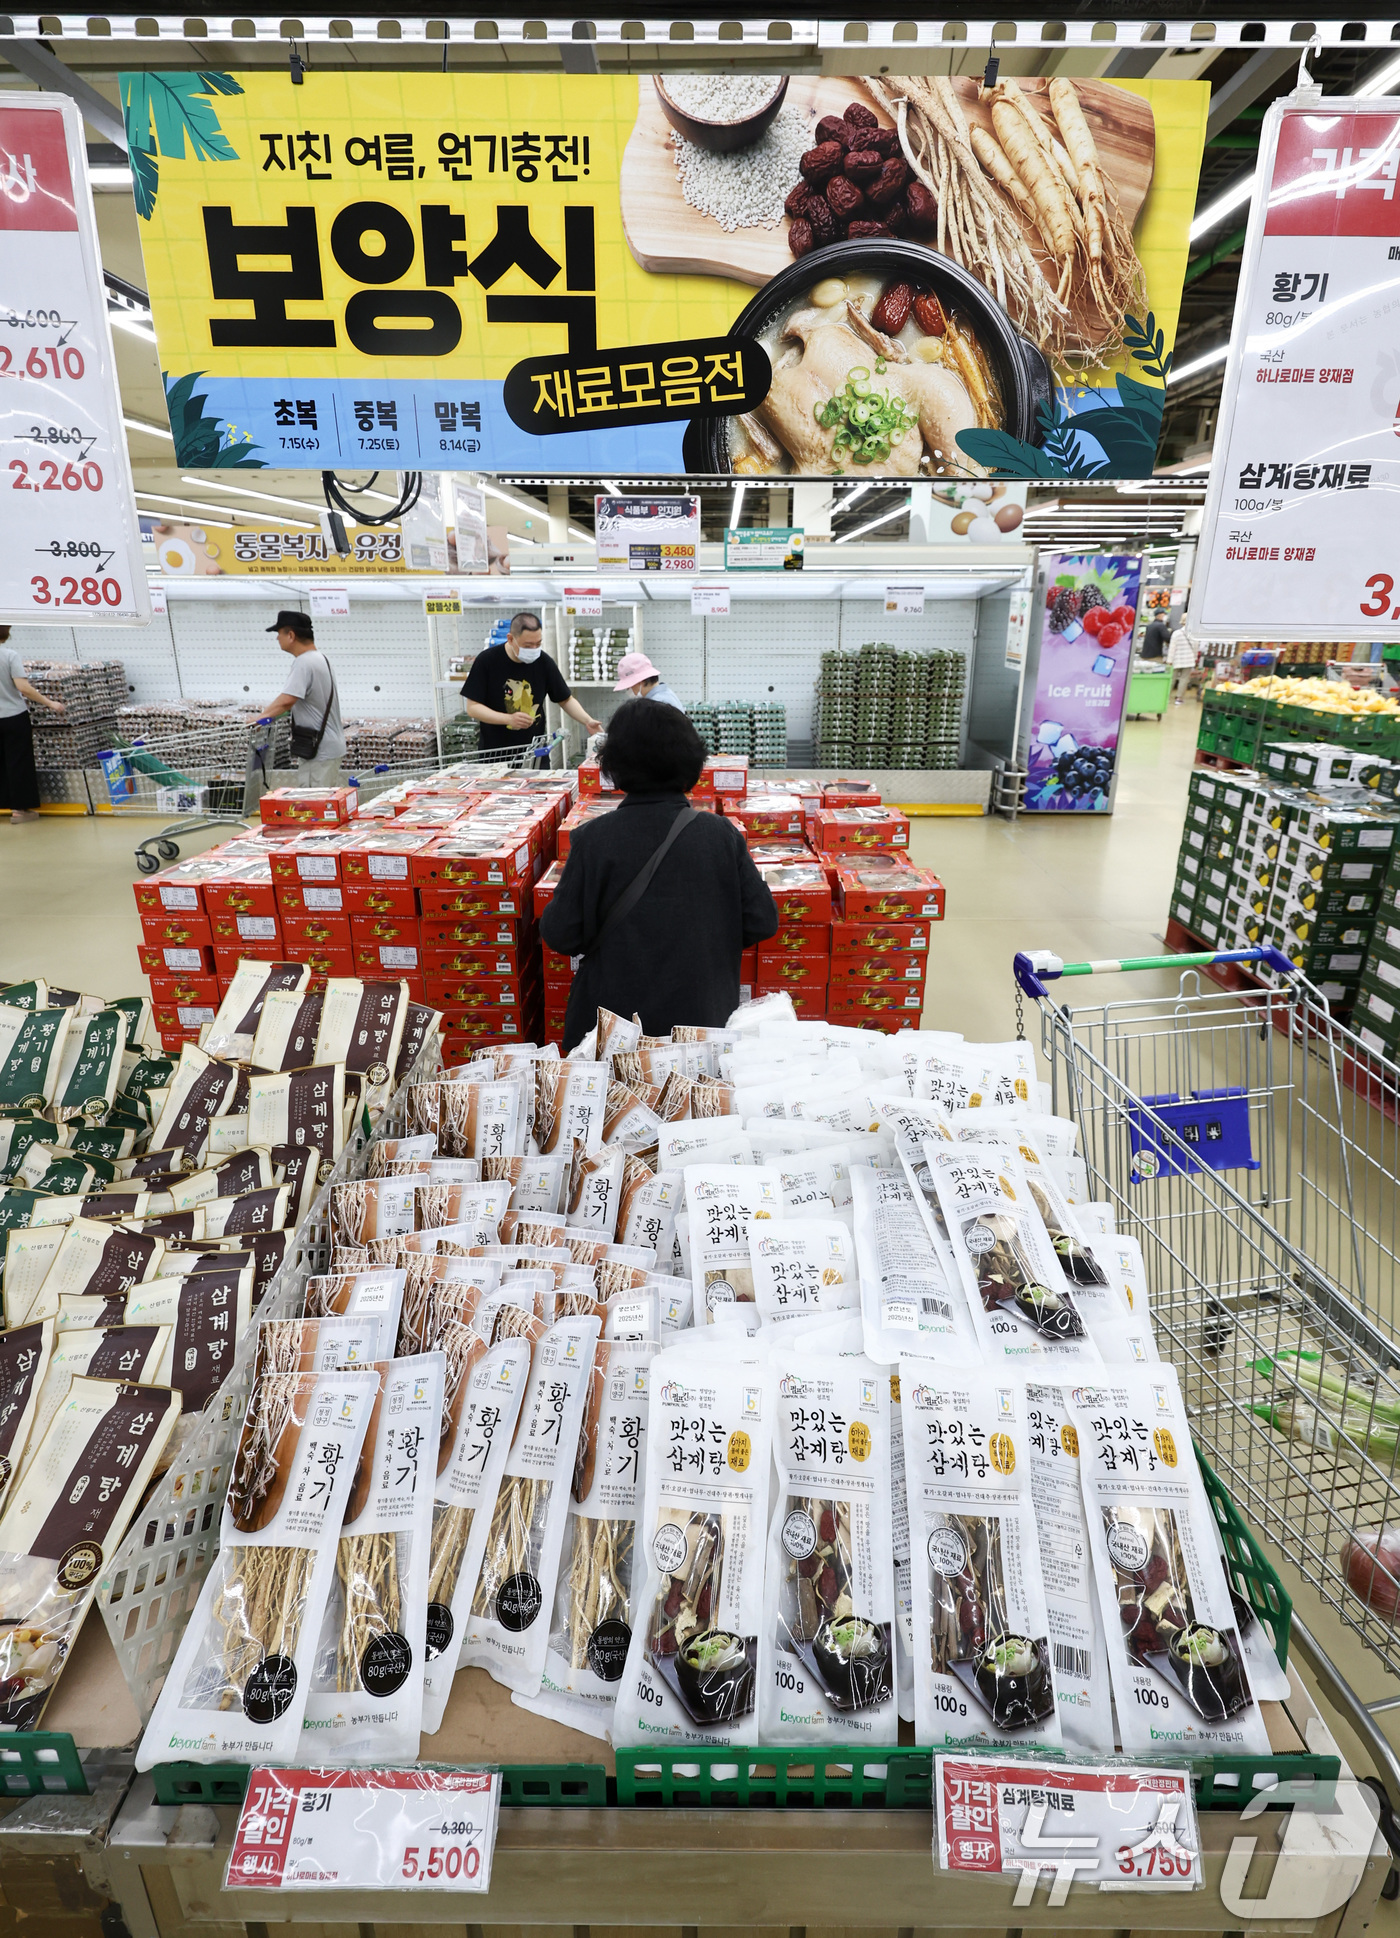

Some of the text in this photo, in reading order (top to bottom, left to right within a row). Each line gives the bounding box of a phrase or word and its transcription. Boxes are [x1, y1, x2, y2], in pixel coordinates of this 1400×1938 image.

[260, 131, 591, 183] 지친 여름, 원기충전!
[201, 200, 597, 357] 보양식
[1272, 272, 1329, 302] 황기
[8, 310, 61, 328] 3,600
[0, 347, 85, 381] 2,610
[1260, 350, 1285, 363] 국산
[531, 348, 746, 418] 재료모음전
[1256, 369, 1354, 384] 하나로마트 양재점
[275, 399, 481, 432] 초복 중복 말복
[31, 427, 82, 444] 2,800
[279, 435, 481, 453] 7.15(수) 7.25(토) 8.14(금)
[9, 460, 103, 492] 2,260
[1238, 463, 1372, 490] 삼계탕재료
[50, 541, 101, 558] 3,800
[234, 532, 330, 562] 동물복지
[1229, 531, 1252, 542] 국산
[665, 546, 694, 556] 3,480
[1226, 547, 1316, 561] 하나로마트 양재점
[665, 559, 694, 571] 2,980
[30, 576, 122, 607] 3,280
[1048, 684, 1113, 698] Ice Fruit
[374, 994, 395, 1043] 삼계탕
[36, 1023, 56, 1053] 황기
[407, 1012, 429, 1055] 삼계탕
[11, 1025, 36, 1072] 삼계탕
[80, 1029, 100, 1076] 삼계탕
[195, 1078, 225, 1133] 삼계탕
[311, 1081, 329, 1139] 삼계탕
[951, 1167, 995, 1183] 맛있는
[592, 1178, 613, 1225] 황기
[707, 1204, 752, 1223] 맛있는
[771, 1262, 819, 1281] 맛있는
[207, 1285, 231, 1361] 삼계탕
[542, 1382, 571, 1446] 황기
[790, 1407, 846, 1433] 맛있는
[468, 1406, 501, 1472] 황기
[670, 1416, 727, 1443] 맛있는
[851, 1427, 866, 1438] 6가지
[926, 1420, 985, 1446] 맛있는
[1091, 1416, 1149, 1441] 맛있는
[618, 1416, 646, 1484] 황기
[731, 1437, 747, 1447] 6가지
[790, 1435, 848, 1464] 삼계탕
[852, 1447, 865, 1457] 재료
[98, 1411, 154, 1502] 삼계탕
[395, 1426, 424, 1493] 황기
[665, 1445, 726, 1475] 삼계탕
[731, 1457, 745, 1467] 재료
[926, 1449, 990, 1478] 삼계탕
[1098, 1444, 1158, 1471] 삼계탕
[309, 1443, 344, 1511] 황기
[83, 1508, 102, 1532] 재료
[69, 1558, 93, 1571] 100%
[368, 1663, 405, 1677] 80g(국산)
[775, 1670, 804, 1694] 100g
[637, 1681, 663, 1706] 100g
[933, 1694, 967, 1716] 100g
[1133, 1687, 1169, 1709] 100g
[303, 1711, 398, 1730] beyond farm 농부가 만듭니다
[638, 1716, 730, 1747] beyond farm 농부가 만듭니다
[780, 1706, 872, 1732] beyond farm 농부가 만듭니다
[168, 1731, 273, 1751] beyond farm 농부가 만듭니다
[945, 1731, 974, 1746] beyond
[1150, 1723, 1244, 1743] beyond farm 농부가 만듭니다
[252, 1787, 292, 1814] 가격
[302, 1792, 331, 1812] 황기
[950, 1779, 992, 1806] 가격
[1002, 1788, 1076, 1812] 삼계탕재료
[242, 1815, 288, 1845] 할인
[440, 1821, 473, 1834] 6,300
[952, 1805, 993, 1832] 할인
[959, 1840, 993, 1861] 행사
[1005, 1847, 1015, 1855] 국산
[1118, 1846, 1192, 1877] 3,750
[242, 1855, 275, 1876] 행사
[402, 1847, 480, 1881] 5,500
